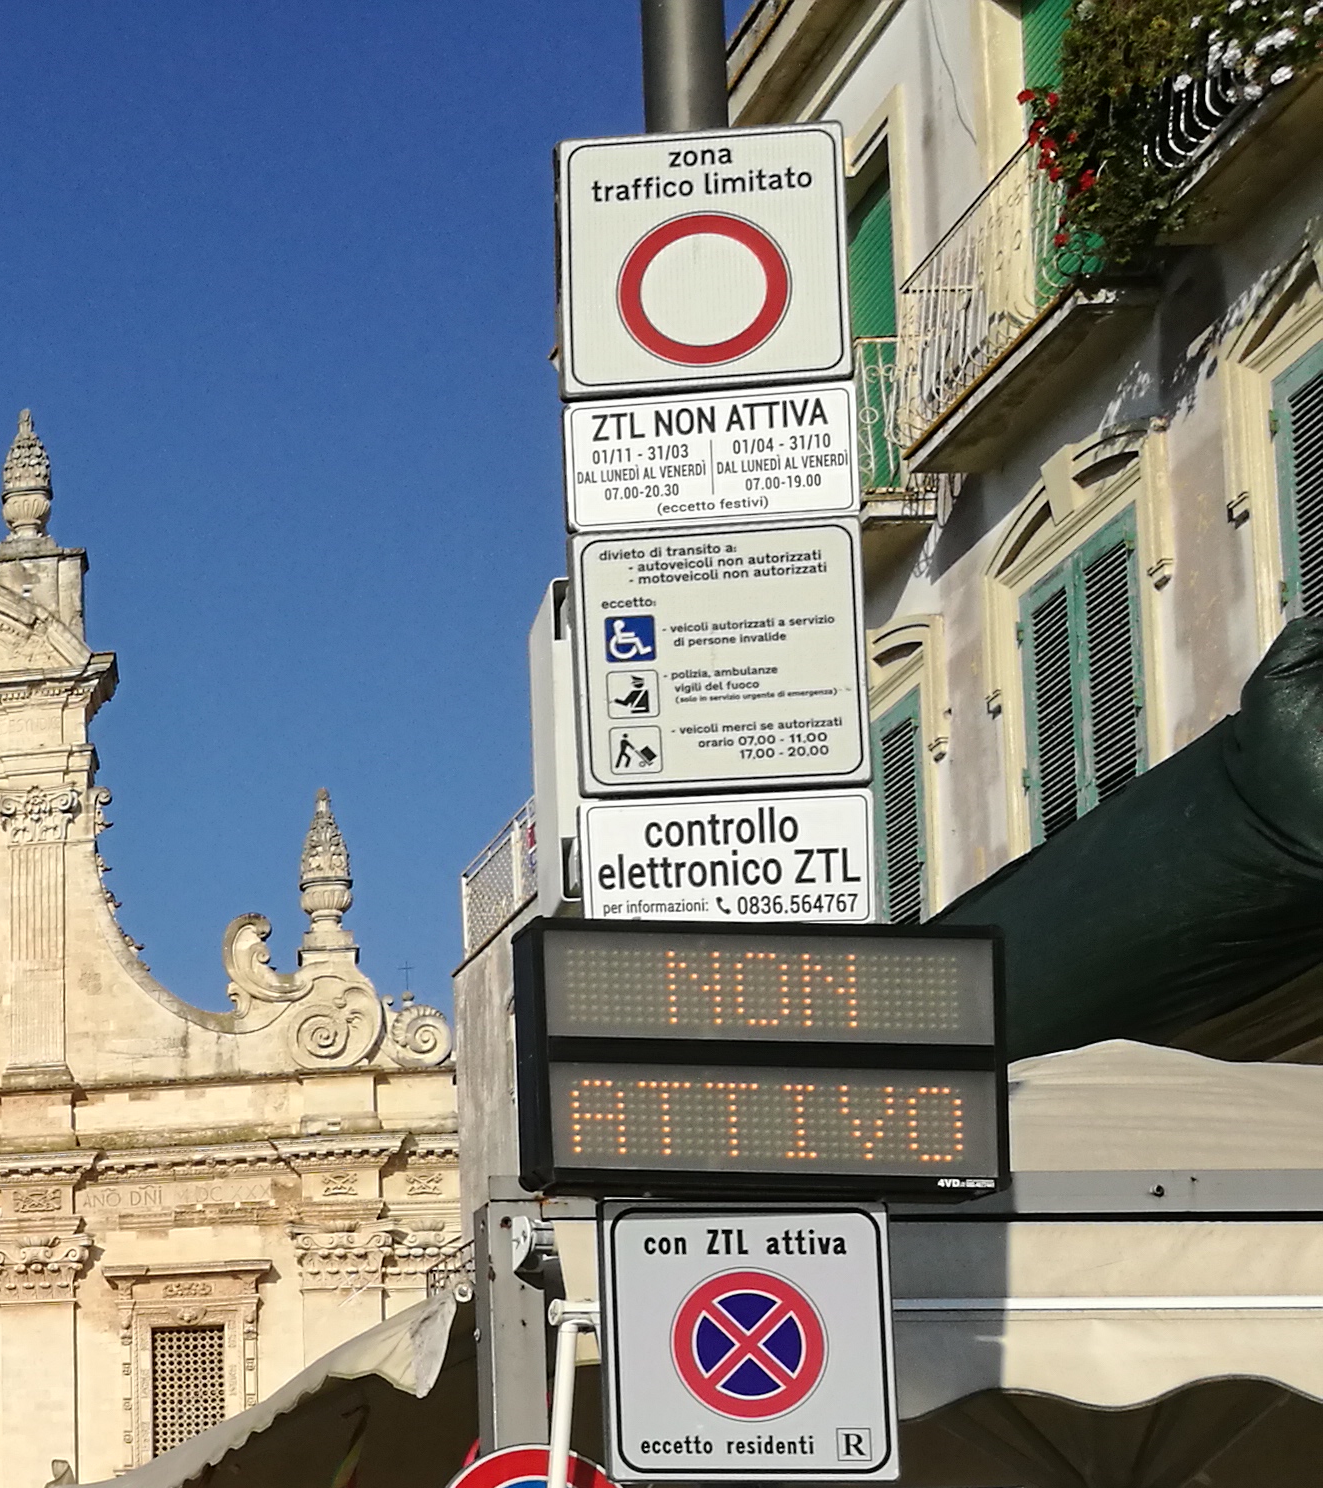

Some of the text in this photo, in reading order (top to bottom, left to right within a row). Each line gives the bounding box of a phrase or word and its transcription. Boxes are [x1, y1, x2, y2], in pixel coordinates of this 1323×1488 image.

[669, 147, 733, 168] zona
[592, 167, 812, 202] traffico limitato
[592, 398, 828, 441] ZTL NON ATTIVA
[592, 444, 689, 464] 01/11 31/03
[733, 433, 831, 454] 01/04 31/10
[578, 460, 706, 484] DAL LUNEDÌ AL VENERDÌ
[717, 449, 848, 474] DAL LUNEDÌ AL VENERDÌ
[605, 484, 679, 500] 07.00-20.30
[745, 474, 821, 491] 07.00-19.00
[657, 496, 768, 516] (eccetto festivi)
[599, 544, 736, 561] divieto di transito a:
[638, 550, 821, 572] autoveicoli non autorizzati
[638, 563, 826, 585] motoveicoli non autorizzati
[601, 597, 656, 609] eccetto:
[670, 615, 834, 633] veicoli autorizzati a servizio
[674, 632, 786, 647] di persone invalide
[714, 666, 778, 677] ambulanze
[675, 681, 759, 693] vigili del fuoco
[680, 717, 842, 735] veicoli merci se autorizzati
[699, 737, 734, 748] orario
[645, 807, 799, 847] controllo
[598, 849, 860, 890] elettronico ZTL
[603, 893, 858, 916] per informazioni: 0836.564767
[665, 950, 858, 1028] NON
[571, 1079, 963, 1161] ATTIVO
[644, 1229, 846, 1255] con ZTL attiva
[641, 1433, 864, 1456] eccetto residenti R
